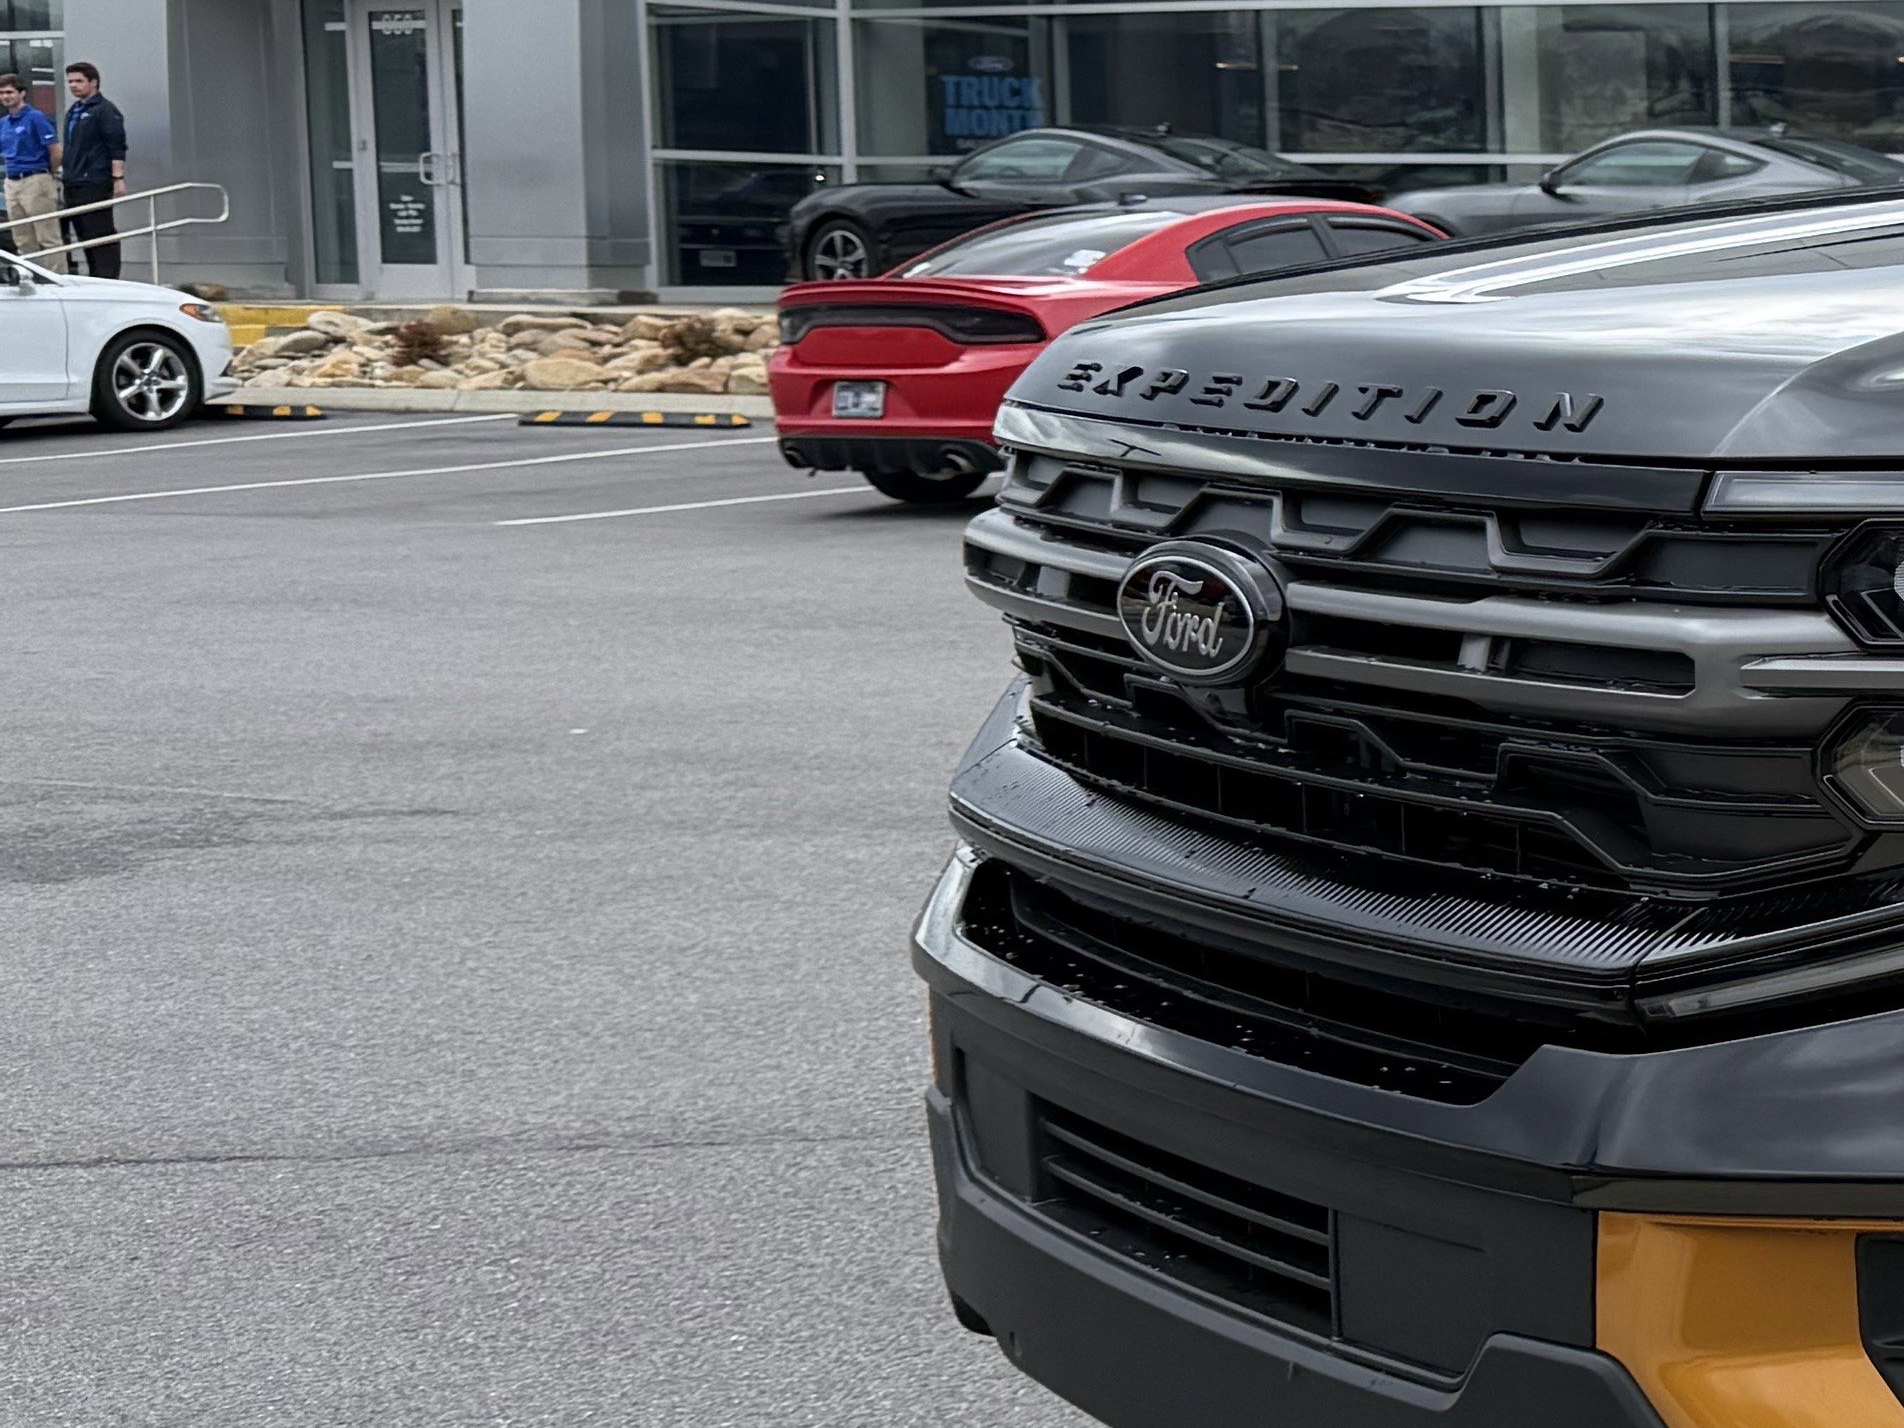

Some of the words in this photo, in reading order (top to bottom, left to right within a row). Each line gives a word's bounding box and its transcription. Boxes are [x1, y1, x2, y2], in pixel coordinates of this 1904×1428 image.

[941, 74, 1041, 108] TRUCK
[1056, 361, 1604, 433] EXPEDITION
[1141, 570, 1226, 658] Ford
